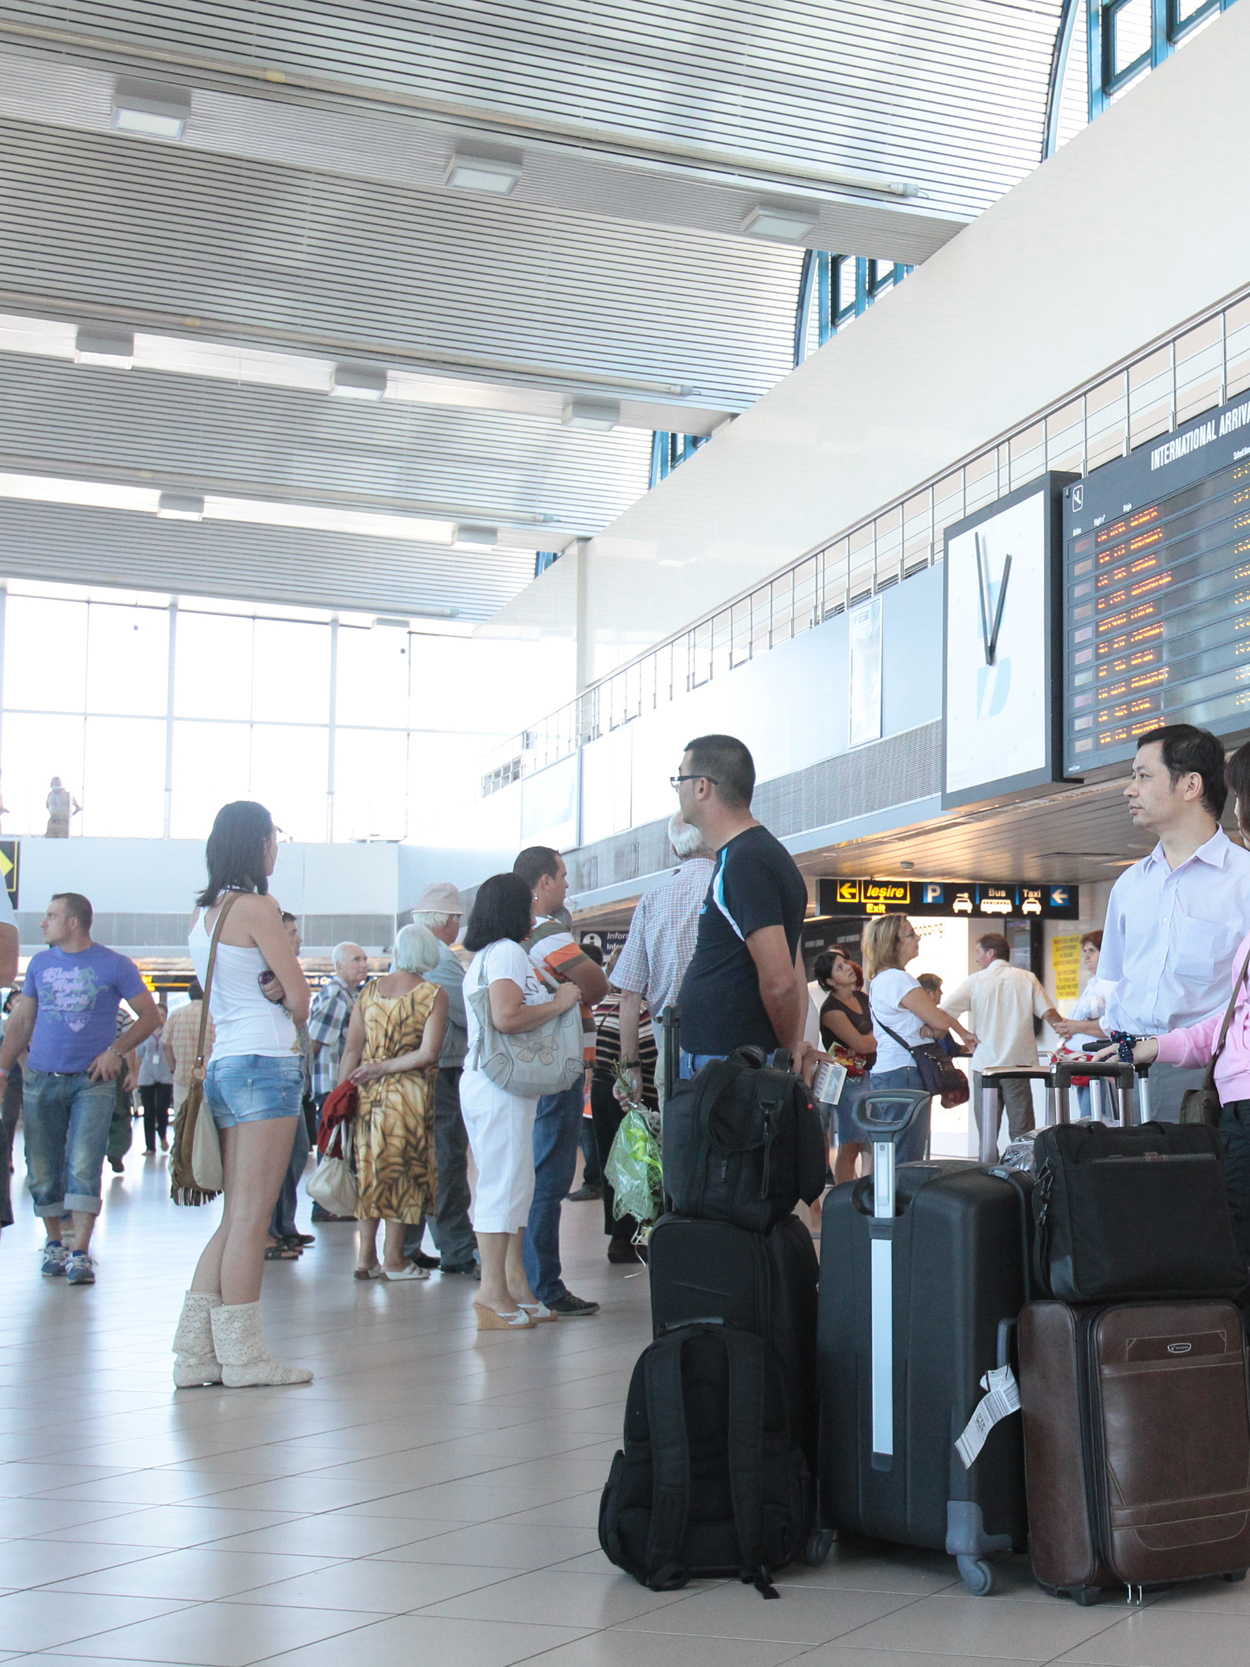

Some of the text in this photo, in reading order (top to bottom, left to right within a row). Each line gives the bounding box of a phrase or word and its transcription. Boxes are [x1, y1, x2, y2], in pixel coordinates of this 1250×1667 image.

[1150, 419, 1217, 472] INTERNATIONAL
[927, 884, 941, 903] P
[988, 888, 1006, 898] Bus
[1022, 889, 1041, 898] Taxi
[866, 903, 886, 914] Exit
[607, 932, 630, 940] Infor
